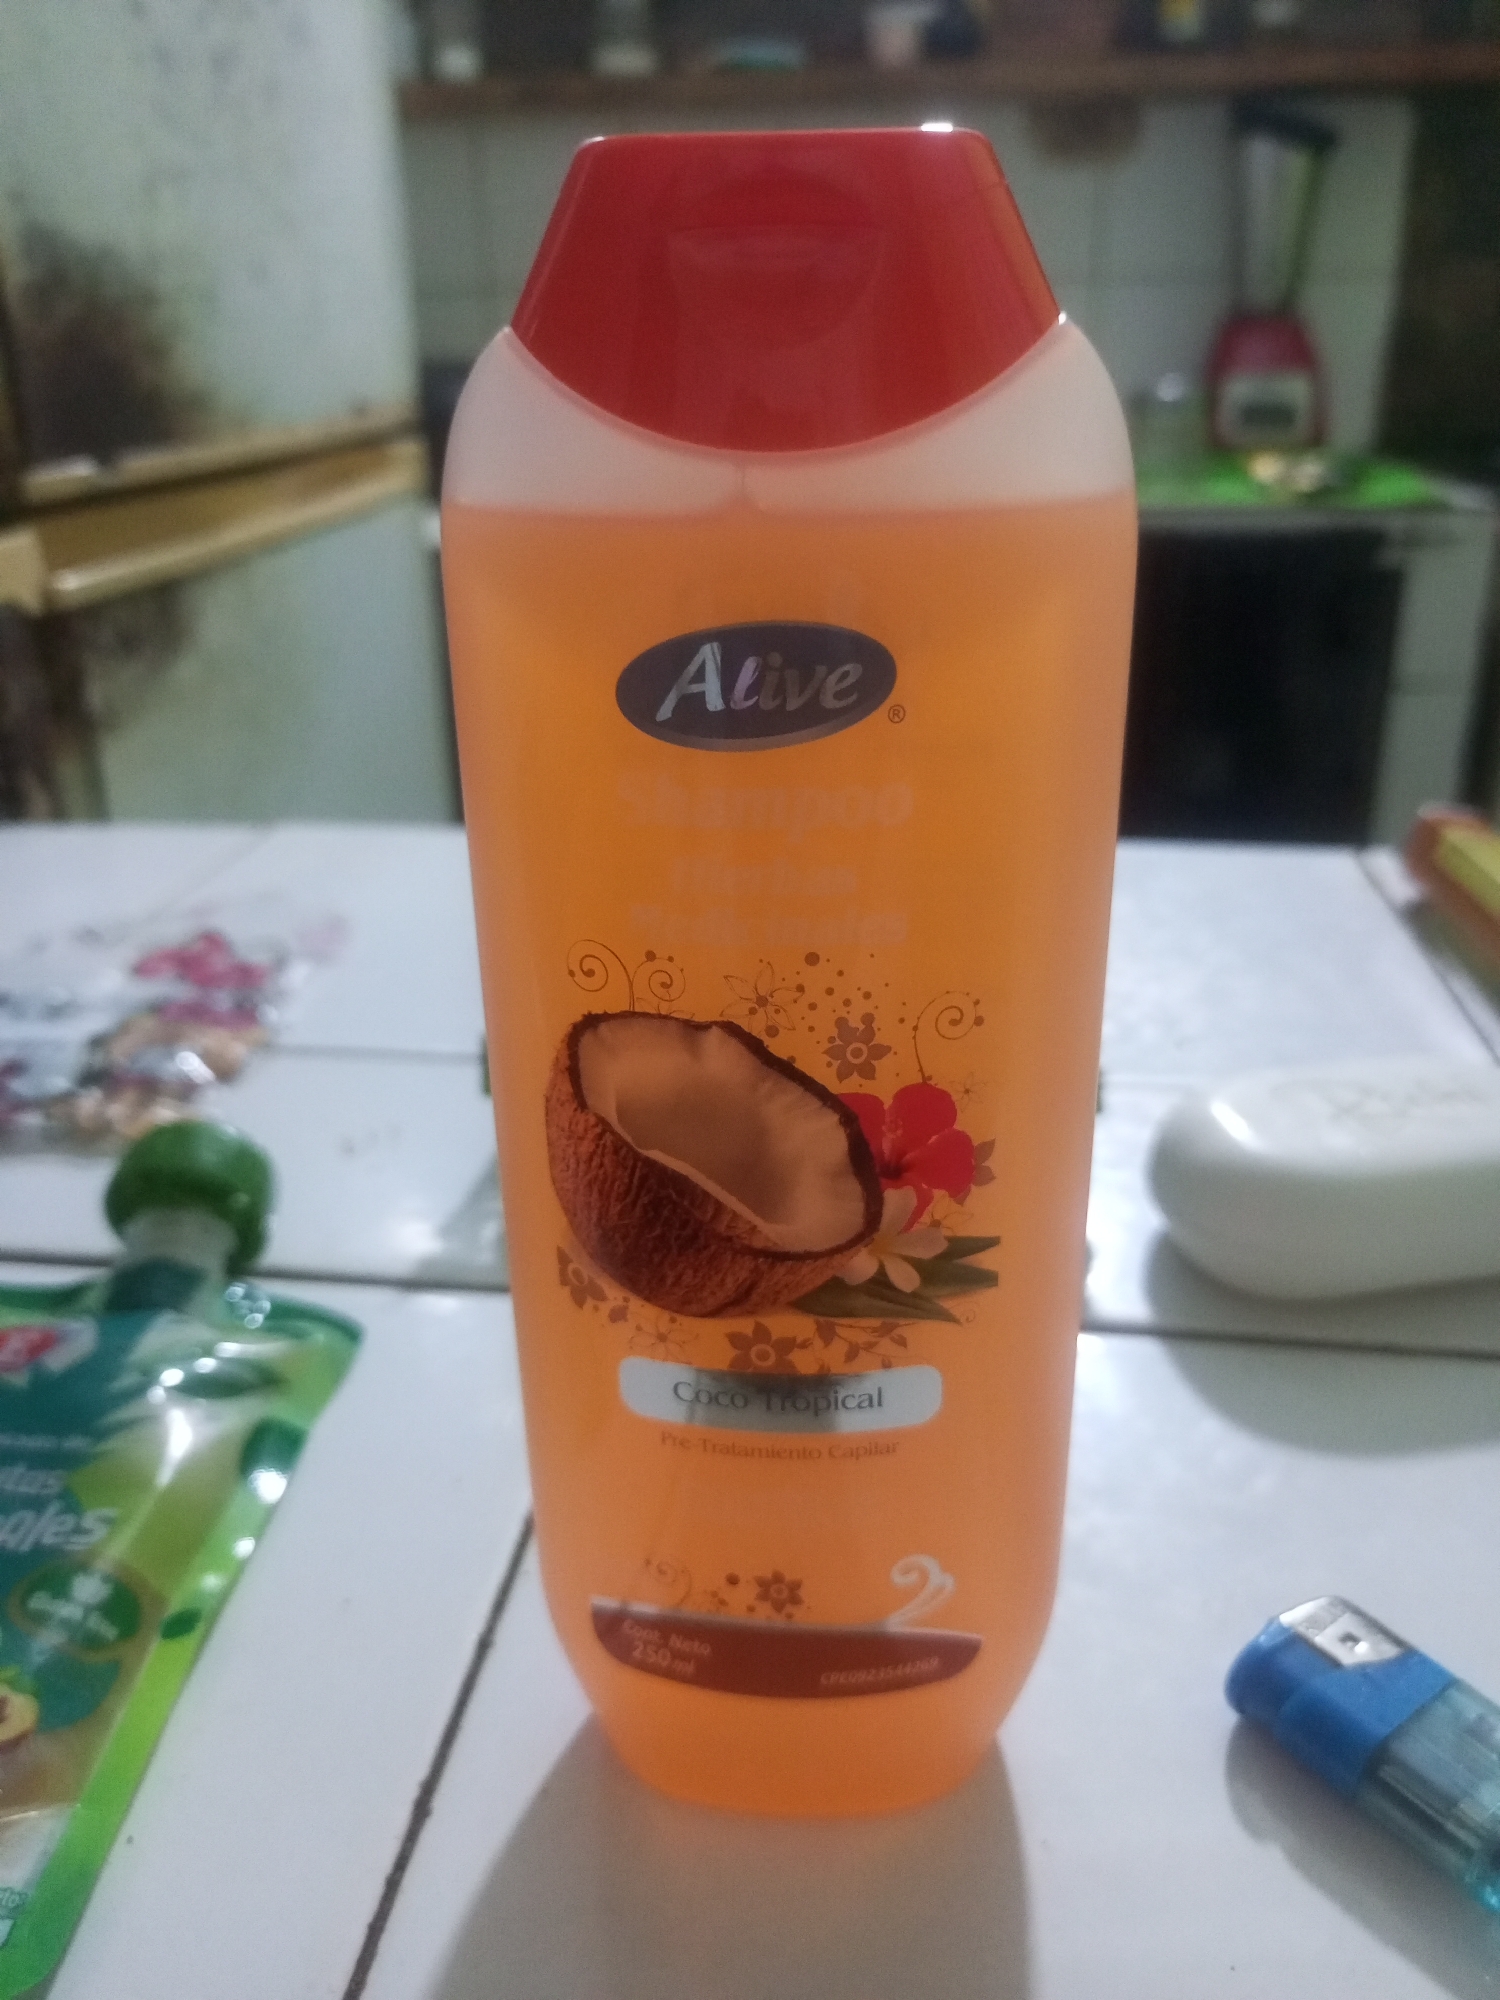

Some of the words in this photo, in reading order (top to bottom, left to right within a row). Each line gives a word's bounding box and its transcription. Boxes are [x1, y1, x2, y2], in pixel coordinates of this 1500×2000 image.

[656, 642, 862, 721] Alive
[617, 773, 914, 844] Shampoo
[673, 1381, 748, 1409] Coco
[765, 1386, 884, 1416] Tropical
[828, 1441, 900, 1461] Capilar
[632, 1641, 671, 1667] 250
